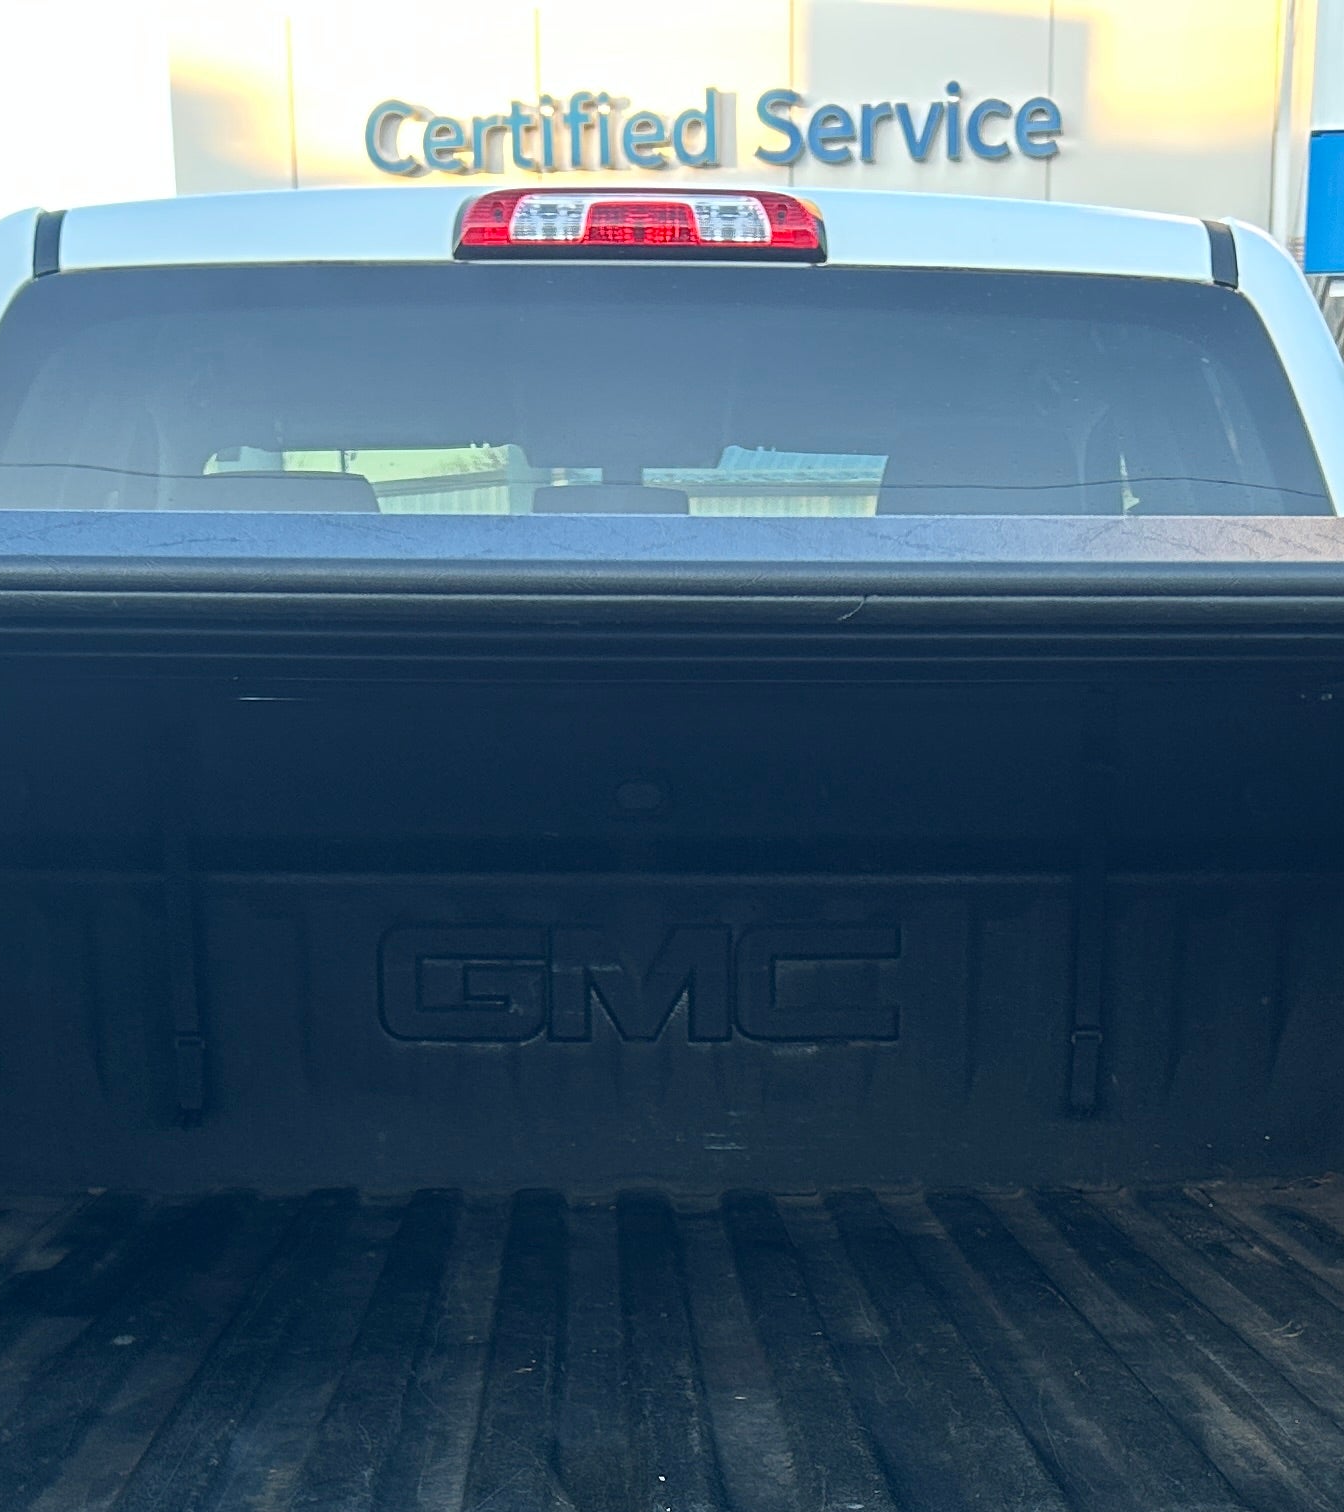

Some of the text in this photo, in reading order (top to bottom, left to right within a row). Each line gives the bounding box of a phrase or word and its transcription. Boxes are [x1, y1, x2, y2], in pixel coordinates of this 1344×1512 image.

[365, 80, 1063, 174] Certified Service
[376, 923, 902, 1044] GMC
